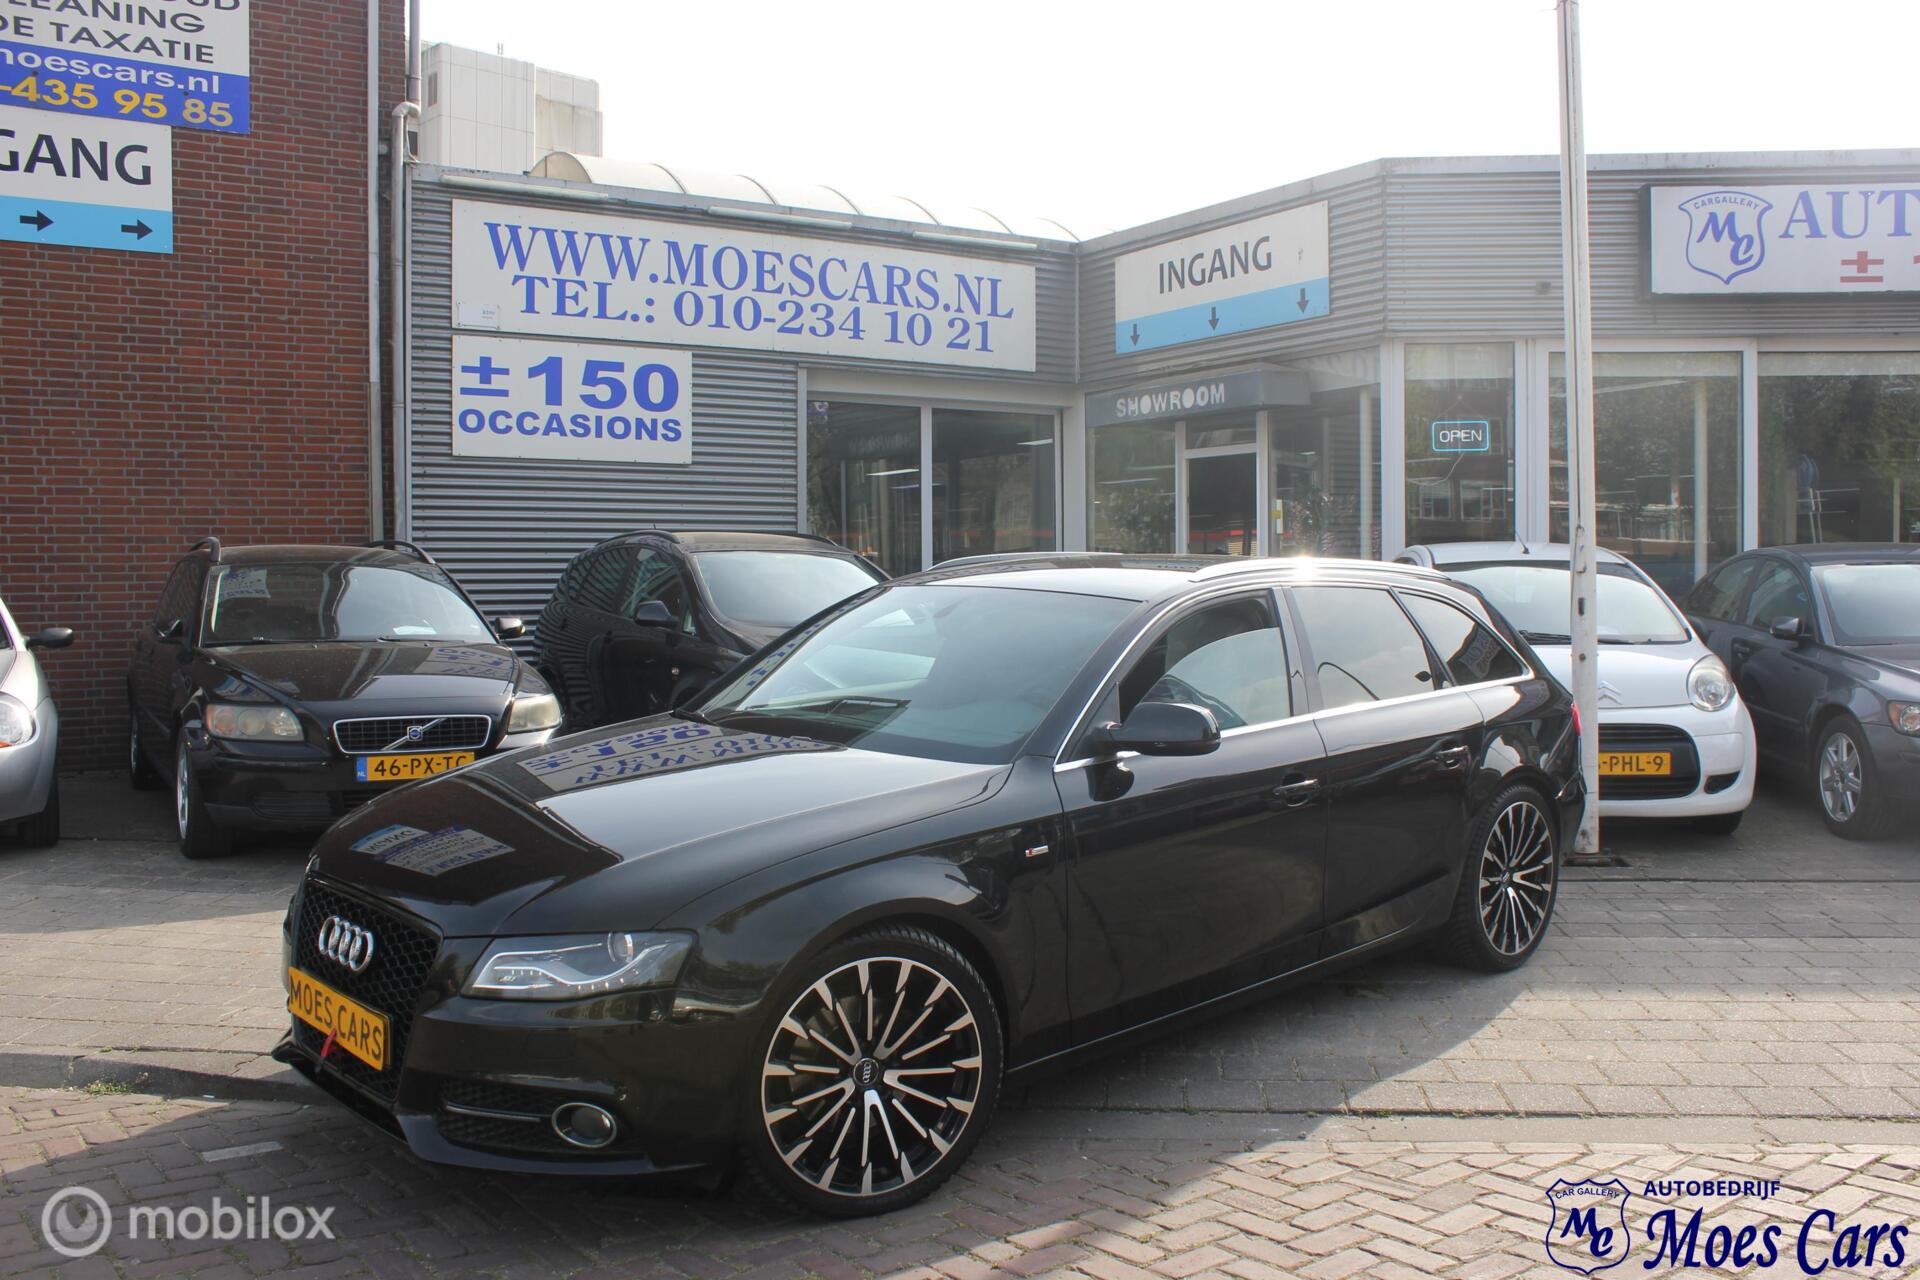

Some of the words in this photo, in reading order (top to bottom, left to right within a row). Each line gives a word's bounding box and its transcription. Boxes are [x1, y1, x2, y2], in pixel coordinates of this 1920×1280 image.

[49, 21, 214, 64] TAXATIE
[113, 88, 168, 119] 95
[182, 98, 234, 127] 85
[483, 221, 1015, 319] WWW.MOESCARS.NL
[1159, 235, 1273, 294] INGANG
[511, 274, 656, 323] TEL.:
[672, 289, 867, 340] 010-234
[883, 312, 933, 347] 10
[945, 318, 995, 352] 21
[1116, 383, 1225, 417] SHOWROOM
[458, 408, 683, 443] OCCASIONS
[1439, 429, 1482, 443] OPEN
[1598, 755, 1664, 773] -PHL-9
[289, 975, 333, 1029] MOES
[337, 1004, 383, 1061] CARS
